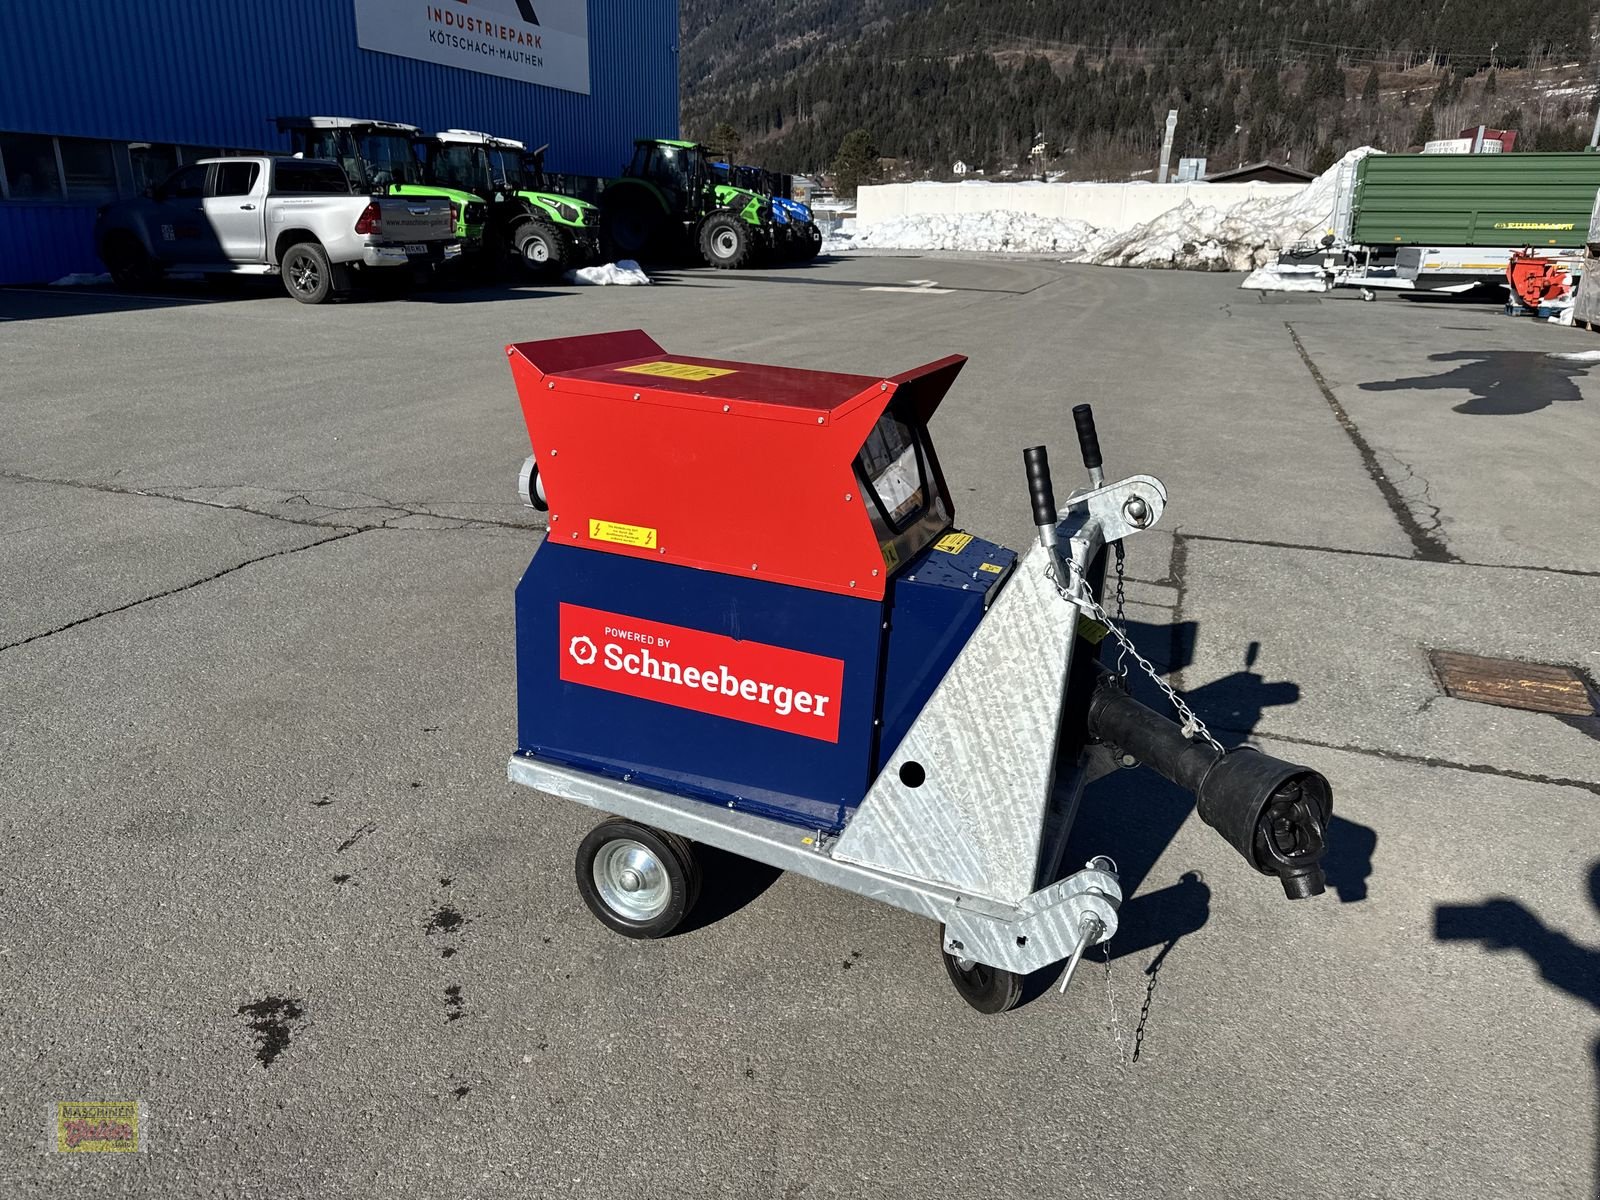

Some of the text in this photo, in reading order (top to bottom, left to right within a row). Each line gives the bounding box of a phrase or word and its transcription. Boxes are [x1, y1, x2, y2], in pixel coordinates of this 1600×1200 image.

[427, 5, 542, 49] INDUSTRIEPARK
[429, 29, 543, 67] KÖTSCHACH-MAUTHEN
[604, 626, 671, 648] POWERED BY
[603, 643, 830, 717] Schneeberger
